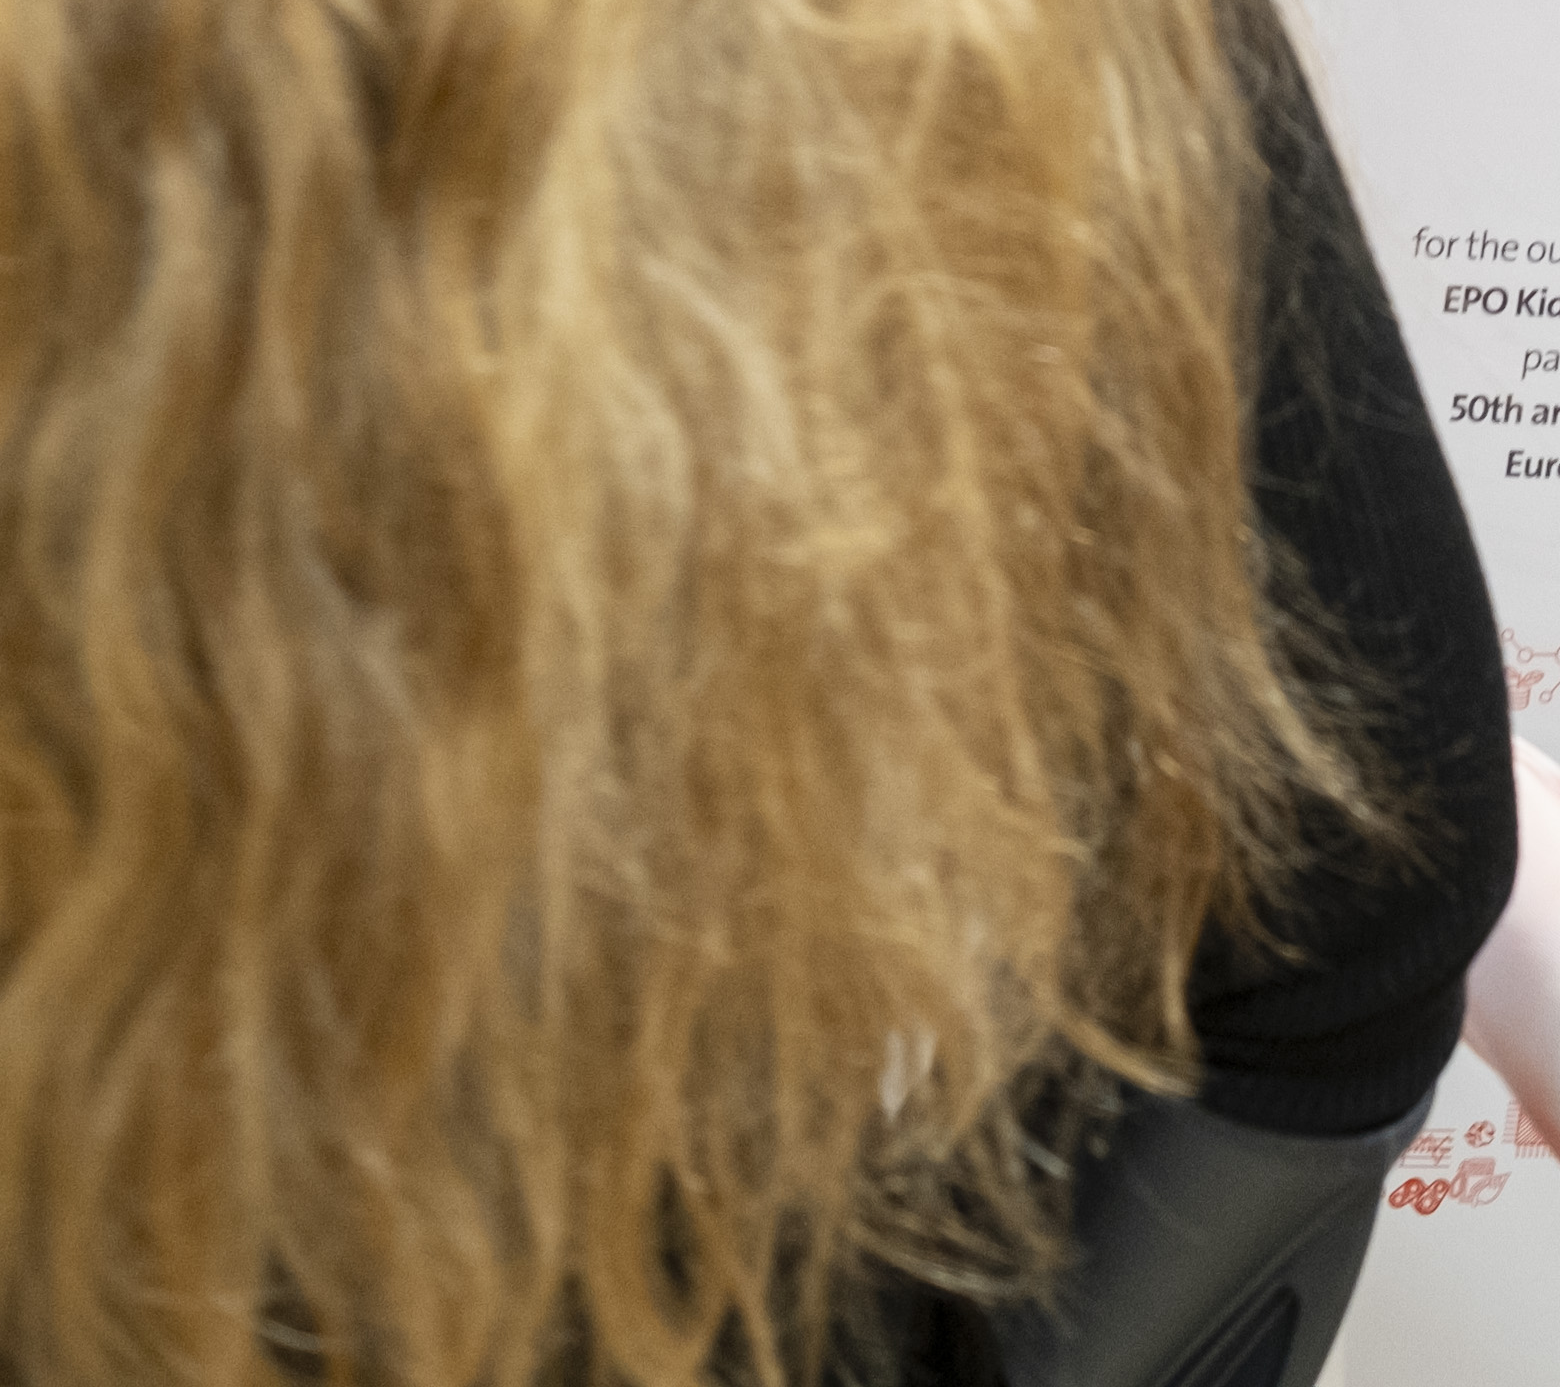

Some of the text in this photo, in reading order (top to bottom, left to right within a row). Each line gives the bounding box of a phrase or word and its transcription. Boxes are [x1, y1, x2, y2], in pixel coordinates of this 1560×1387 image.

[1412, 225, 1459, 259] for
[1466, 229, 1520, 263] the
[1442, 284, 1508, 316] EPO
[1449, 393, 1524, 425] 50th
